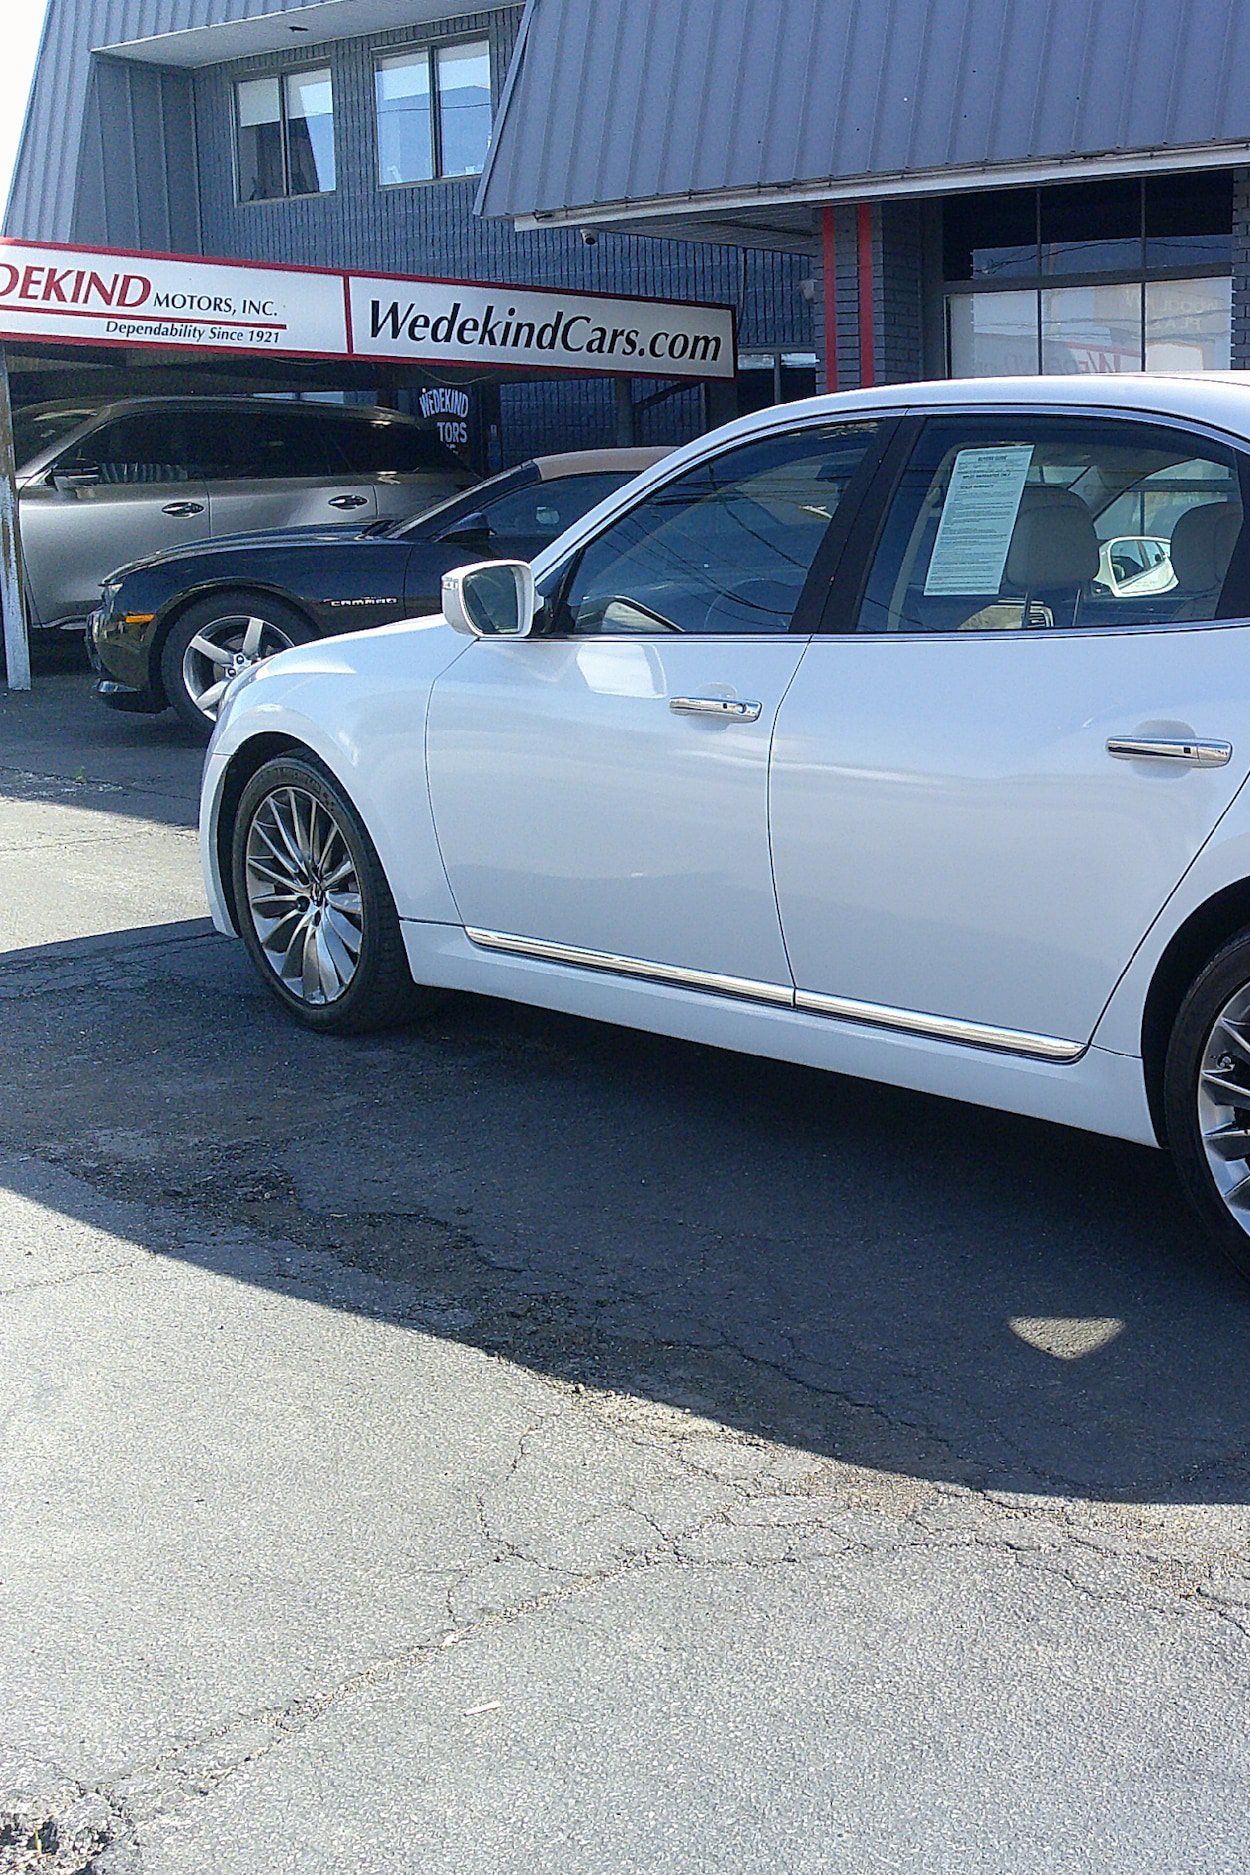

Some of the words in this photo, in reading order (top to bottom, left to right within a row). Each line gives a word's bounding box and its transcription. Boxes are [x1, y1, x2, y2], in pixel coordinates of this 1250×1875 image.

[153, 293, 237, 315] MOTORS,
[242, 299, 278, 317] INC.
[105, 321, 206, 341] Dependability
[208, 326, 244, 342] Since
[248, 330, 280, 344] 1921
[368, 299, 722, 362] WedekindCars.com
[419, 387, 469, 419] WEDEKIND
